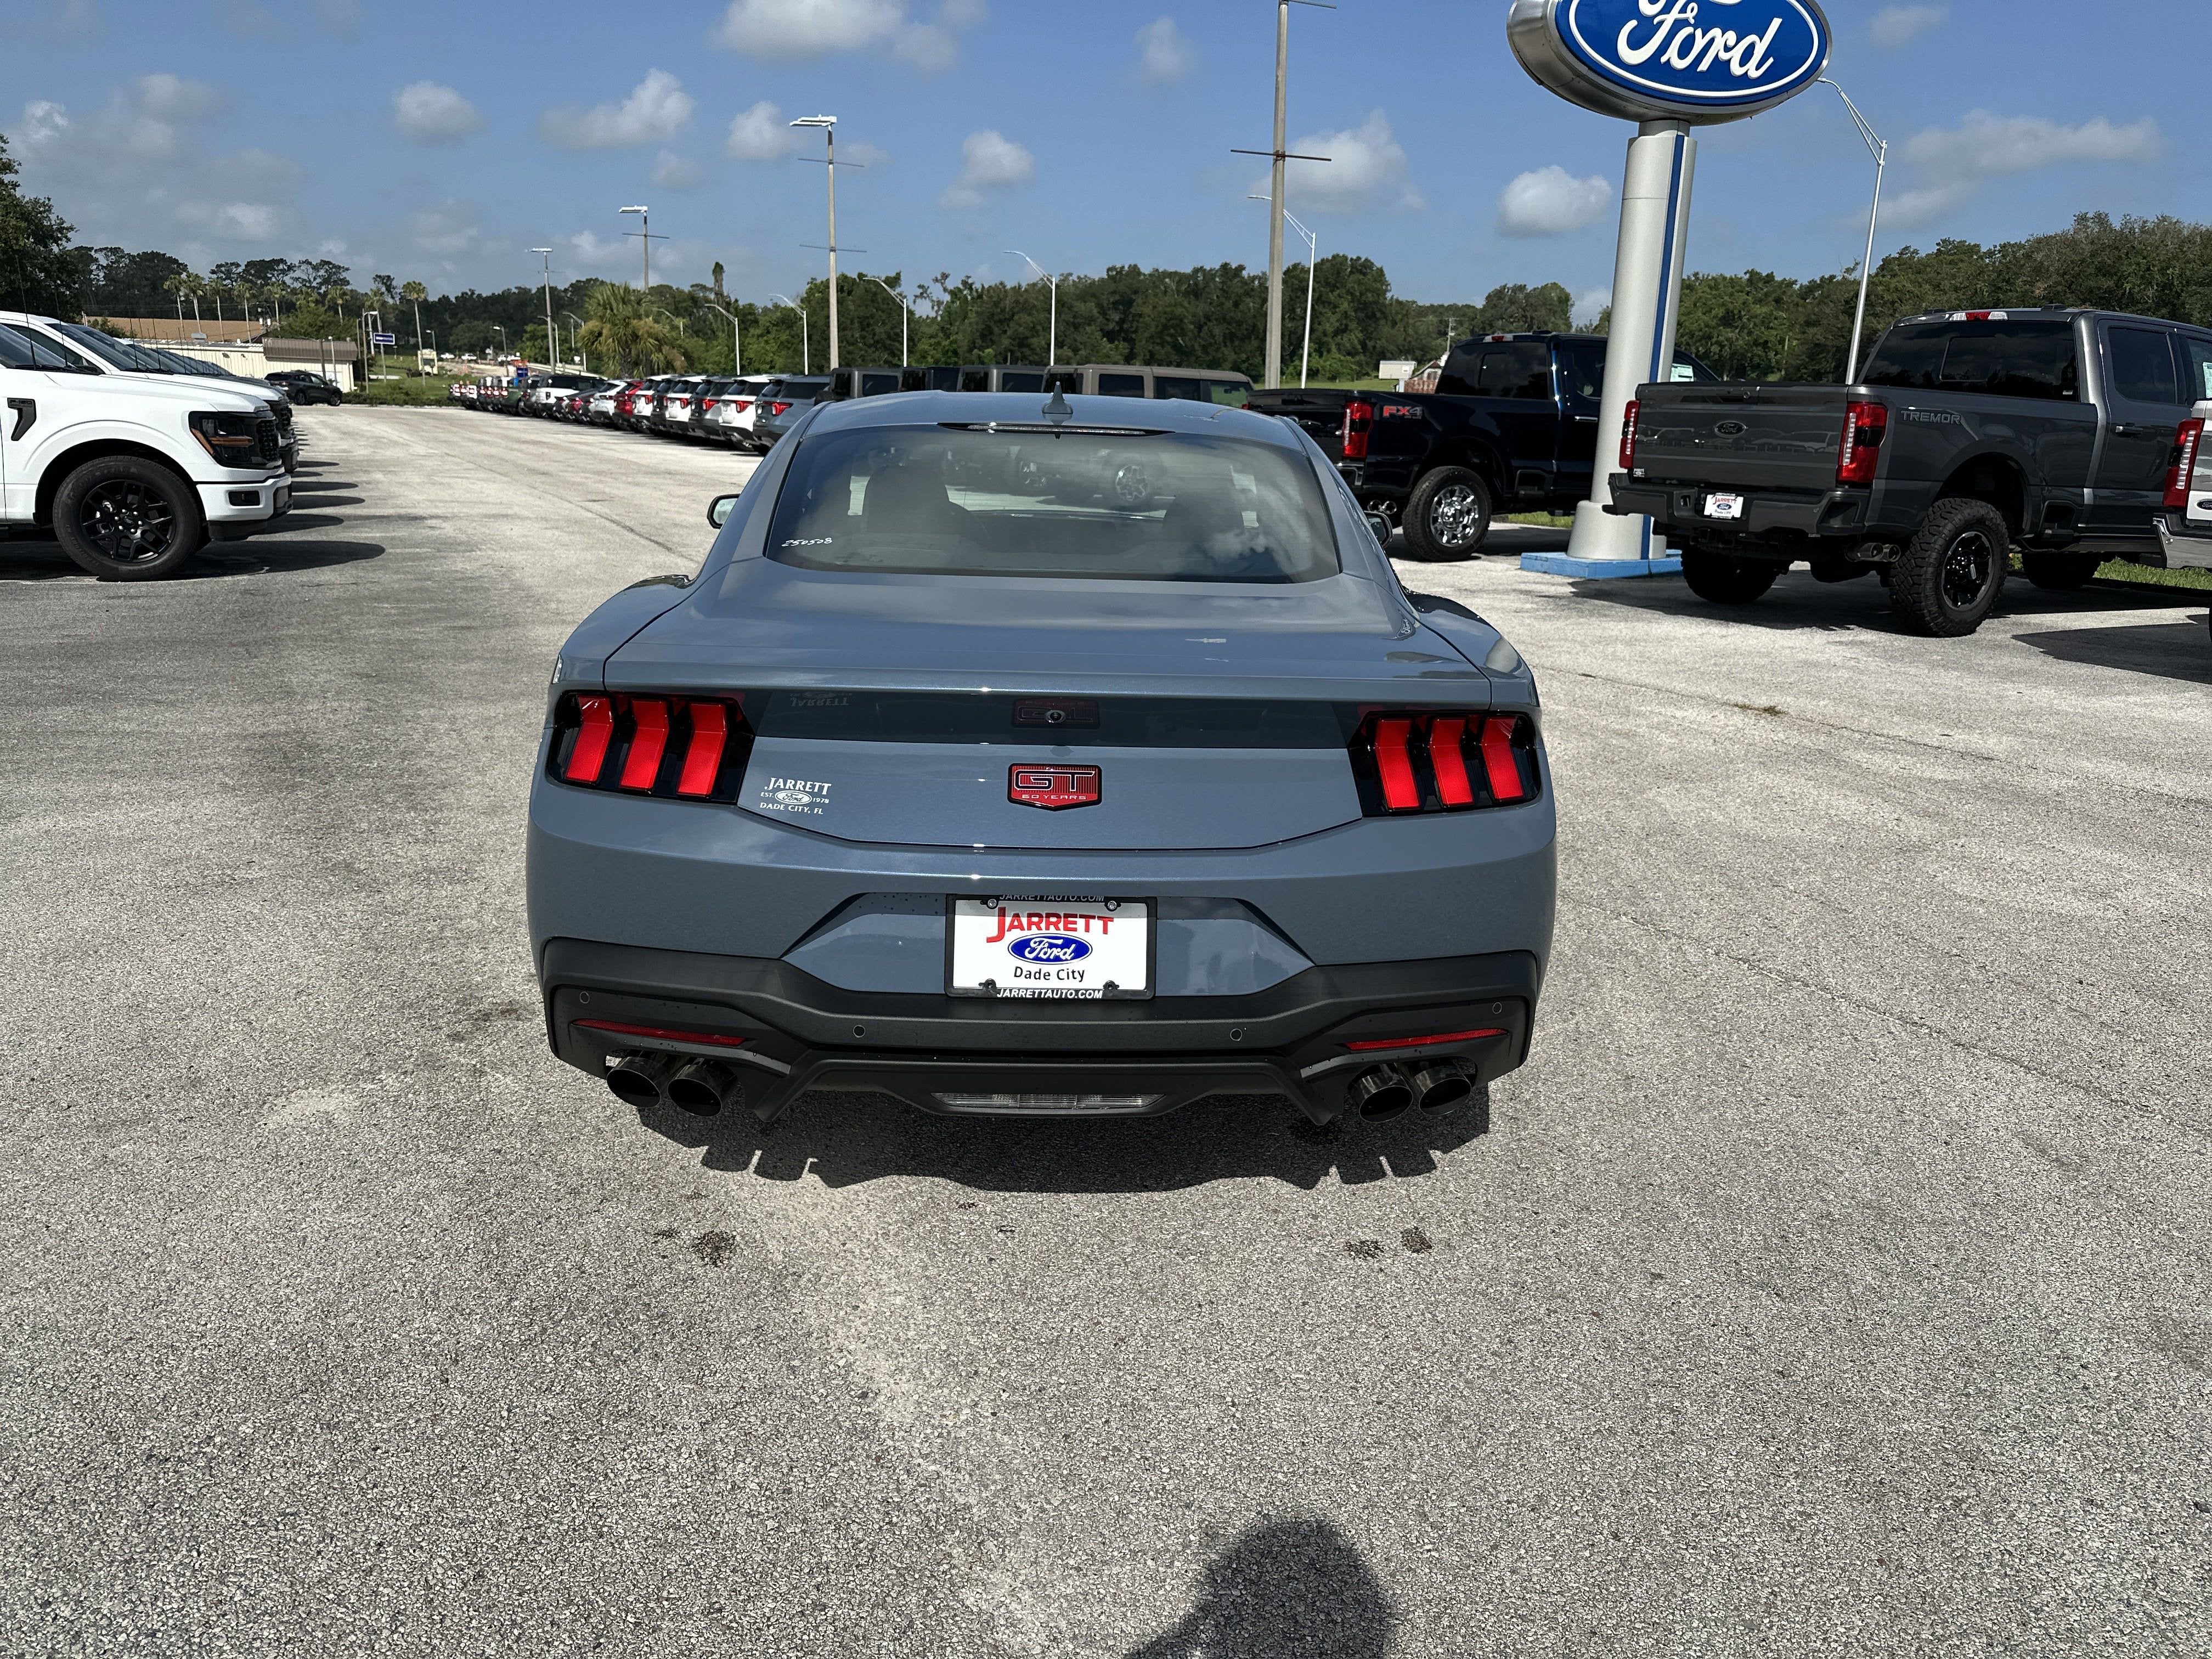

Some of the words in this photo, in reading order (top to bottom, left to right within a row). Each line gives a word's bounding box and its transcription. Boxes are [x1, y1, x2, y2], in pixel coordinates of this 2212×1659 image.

[1617, 0, 1782, 79] Ford
[1383, 405, 1422, 417] FX4
[1901, 410, 1961, 424] TREMOR
[781, 538, 833, 547] 250508
[764, 777, 832, 795] JARRETT
[1014, 769, 1095, 791] GT
[782, 793, 804, 802] Ford
[760, 802, 785, 810] DADE
[788, 805, 811, 814] CITY,
[986, 906, 1114, 943] JARRETT
[1024, 938, 1076, 960] Ford
[1014, 966, 1051, 980] Dade
[1057, 968, 1085, 983] City
[996, 988, 1103, 1000] JARRETTAUTO.COM
